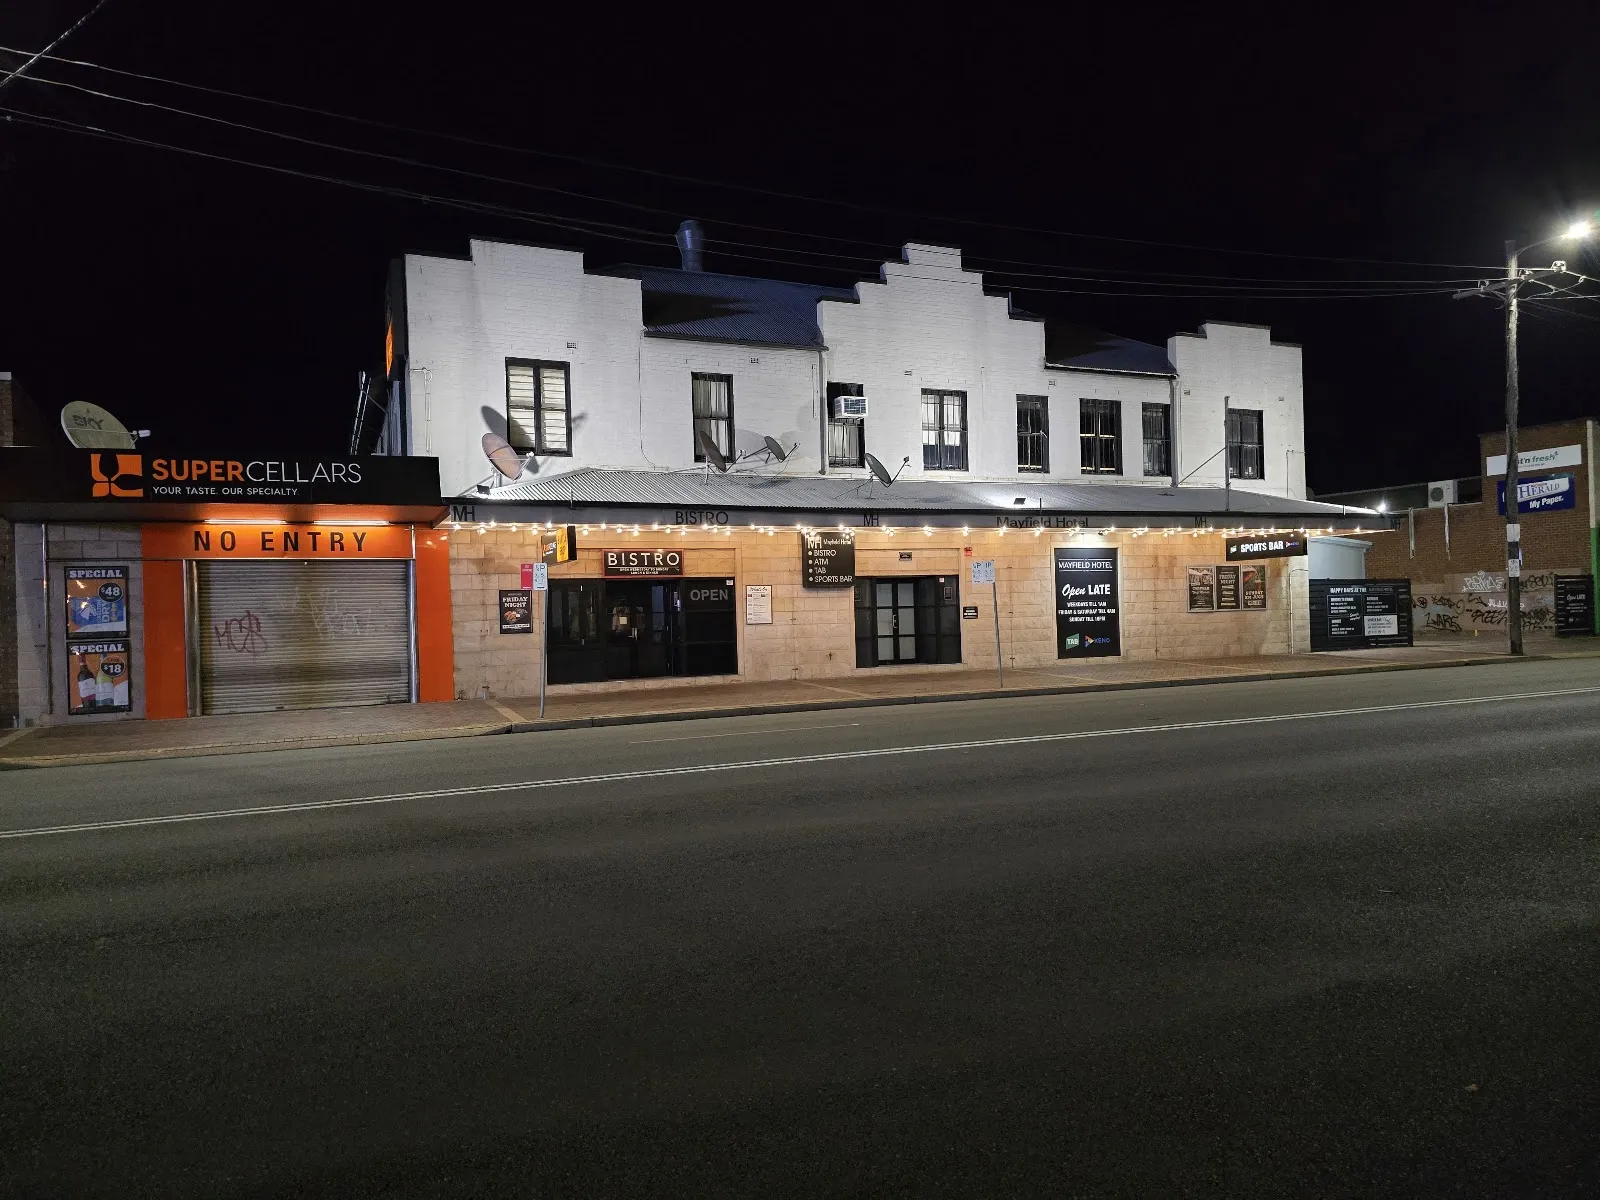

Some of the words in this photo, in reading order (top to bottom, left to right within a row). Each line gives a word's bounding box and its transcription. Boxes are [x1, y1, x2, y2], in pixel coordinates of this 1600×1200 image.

[152, 459, 362, 484] SUPERCELLARS
[152, 486, 182, 495] YOUR
[185, 487, 219, 495] TASTE.
[221, 487, 244, 495] OUR
[1518, 482, 1560, 499] HERALD
[1529, 500, 1541, 509] My
[1541, 495, 1564, 506] Paper.
[453, 505, 476, 522] MH
[675, 510, 729, 525] BISTRO
[863, 513, 879, 527] MH
[996, 516, 1052, 529] Mayfield
[1055, 517, 1089, 528] Hotel
[1194, 516, 1207, 528] MH
[193, 530, 237, 552] NO
[261, 531, 368, 553] ENTRY
[1240, 542, 1267, 553] SPORTS
[1268, 540, 1284, 551] BAR
[607, 552, 680, 566] BISTRO
[813, 549, 837, 557] BISTRO
[813, 558, 829, 566] ATM
[1058, 561, 1091, 569] MAYFIELD
[69, 569, 123, 578] SPECIAL
[101, 586, 120, 596] $48
[689, 589, 729, 601] OPEN
[1061, 583, 1087, 600] Open
[1087, 584, 1111, 595] LATE
[70, 643, 125, 654] SPECIAL
[103, 664, 122, 674] $18
